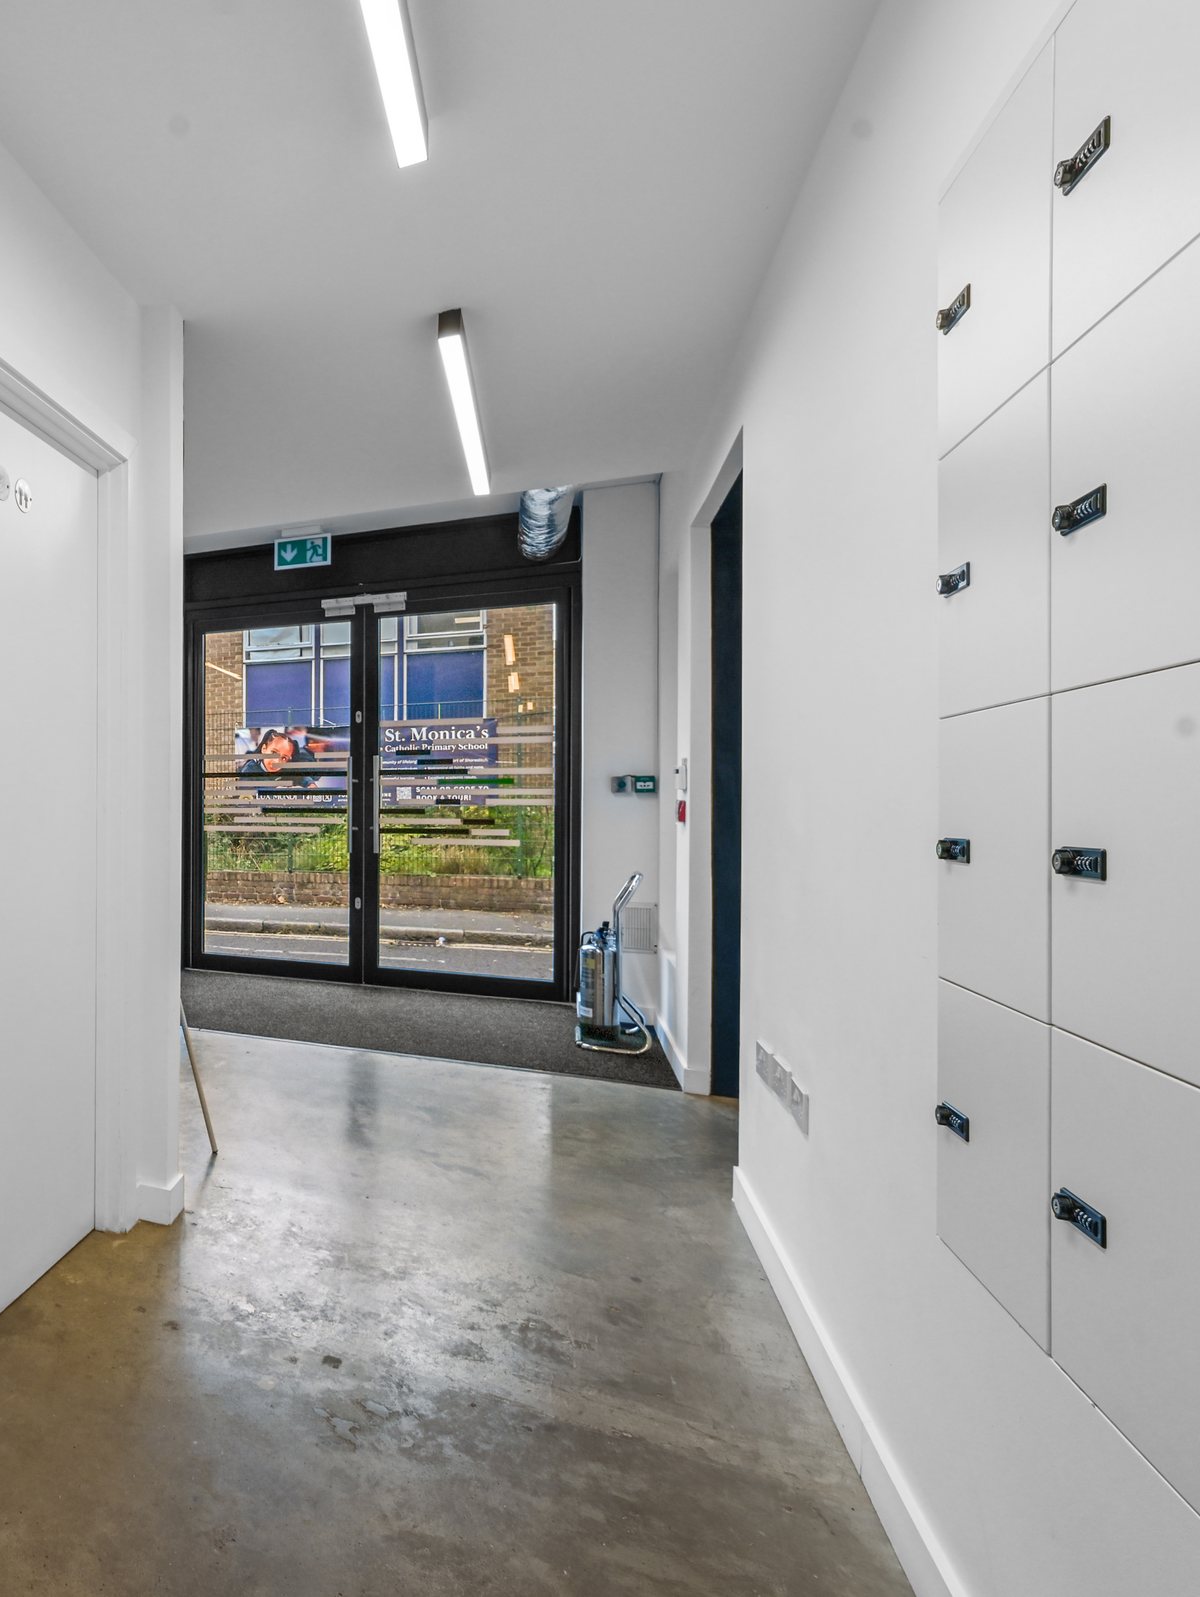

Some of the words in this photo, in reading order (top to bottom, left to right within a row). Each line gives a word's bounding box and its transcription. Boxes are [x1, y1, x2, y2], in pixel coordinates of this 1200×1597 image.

[384, 728, 405, 742] St.
[410, 726, 489, 742] Monica's
[384, 744, 420, 753] Catholic
[421, 743, 457, 753] Primary
